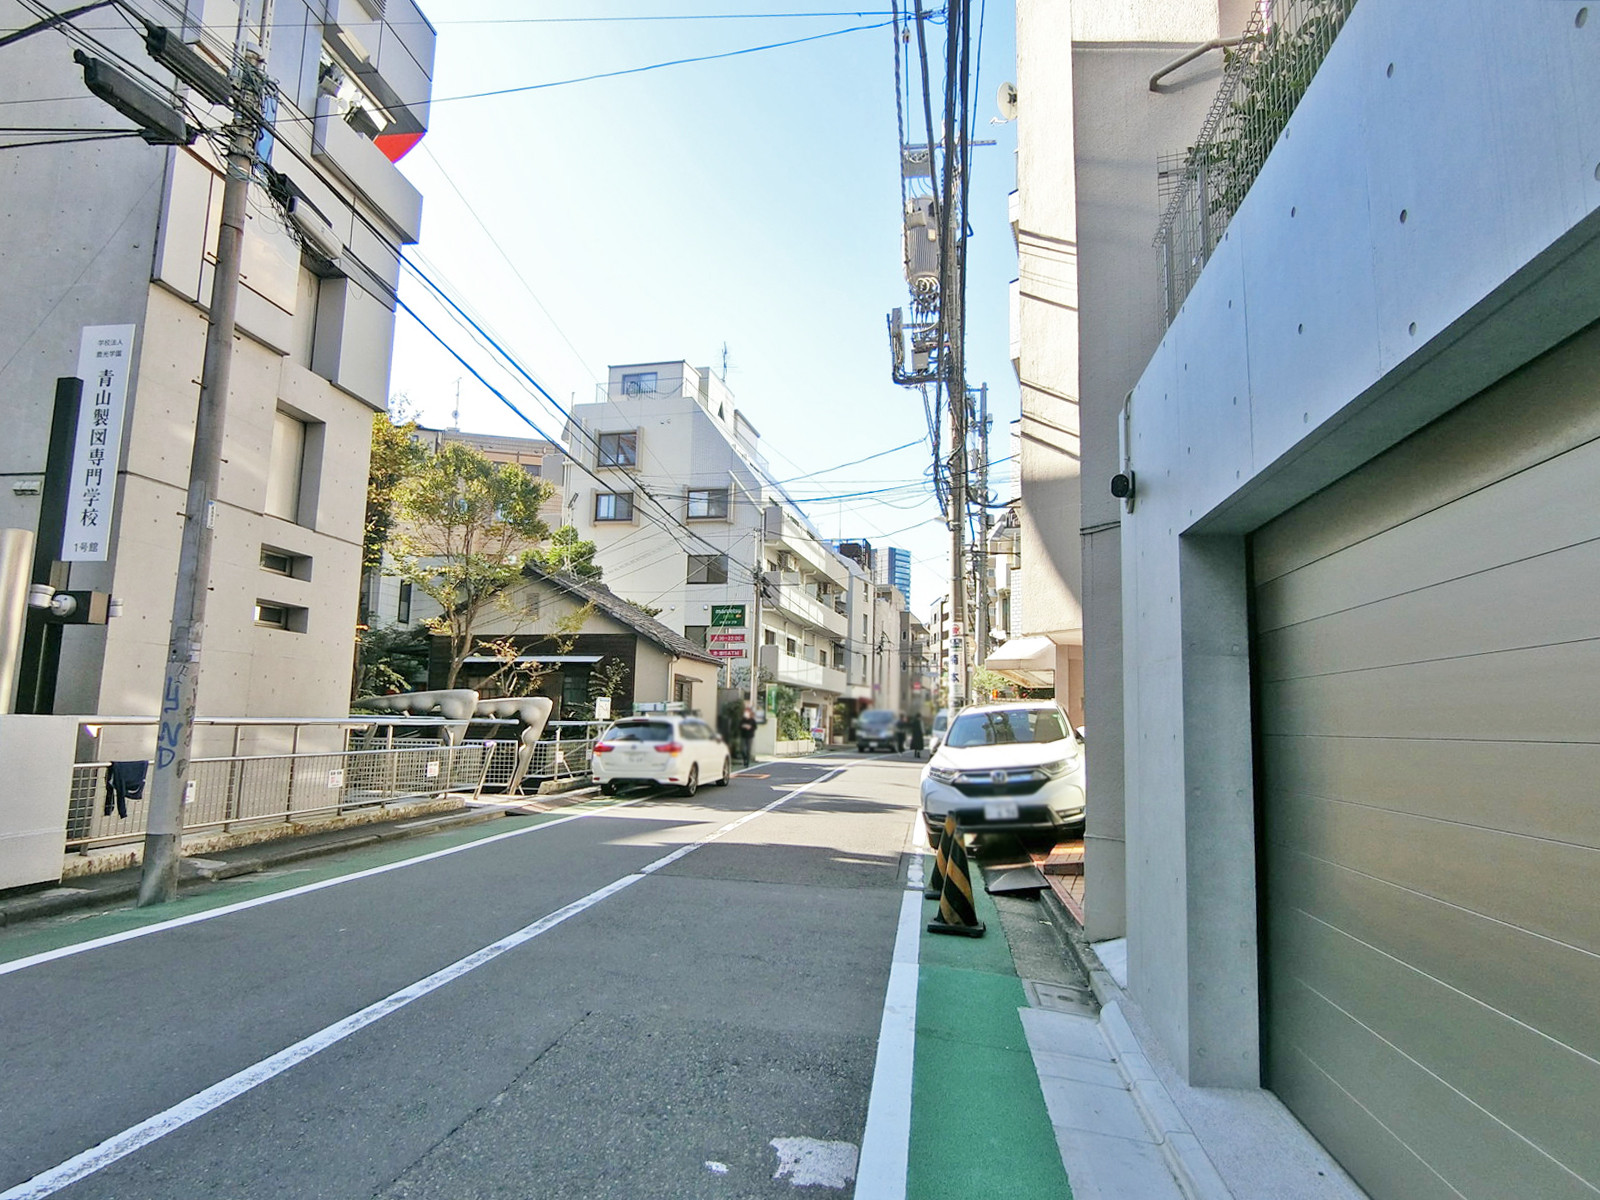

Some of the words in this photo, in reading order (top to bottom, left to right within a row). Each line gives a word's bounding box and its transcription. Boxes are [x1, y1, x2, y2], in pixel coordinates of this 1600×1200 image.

[80, 369, 114, 527] 青山製図専門学校
[74, 542, 99, 553] 1号館
